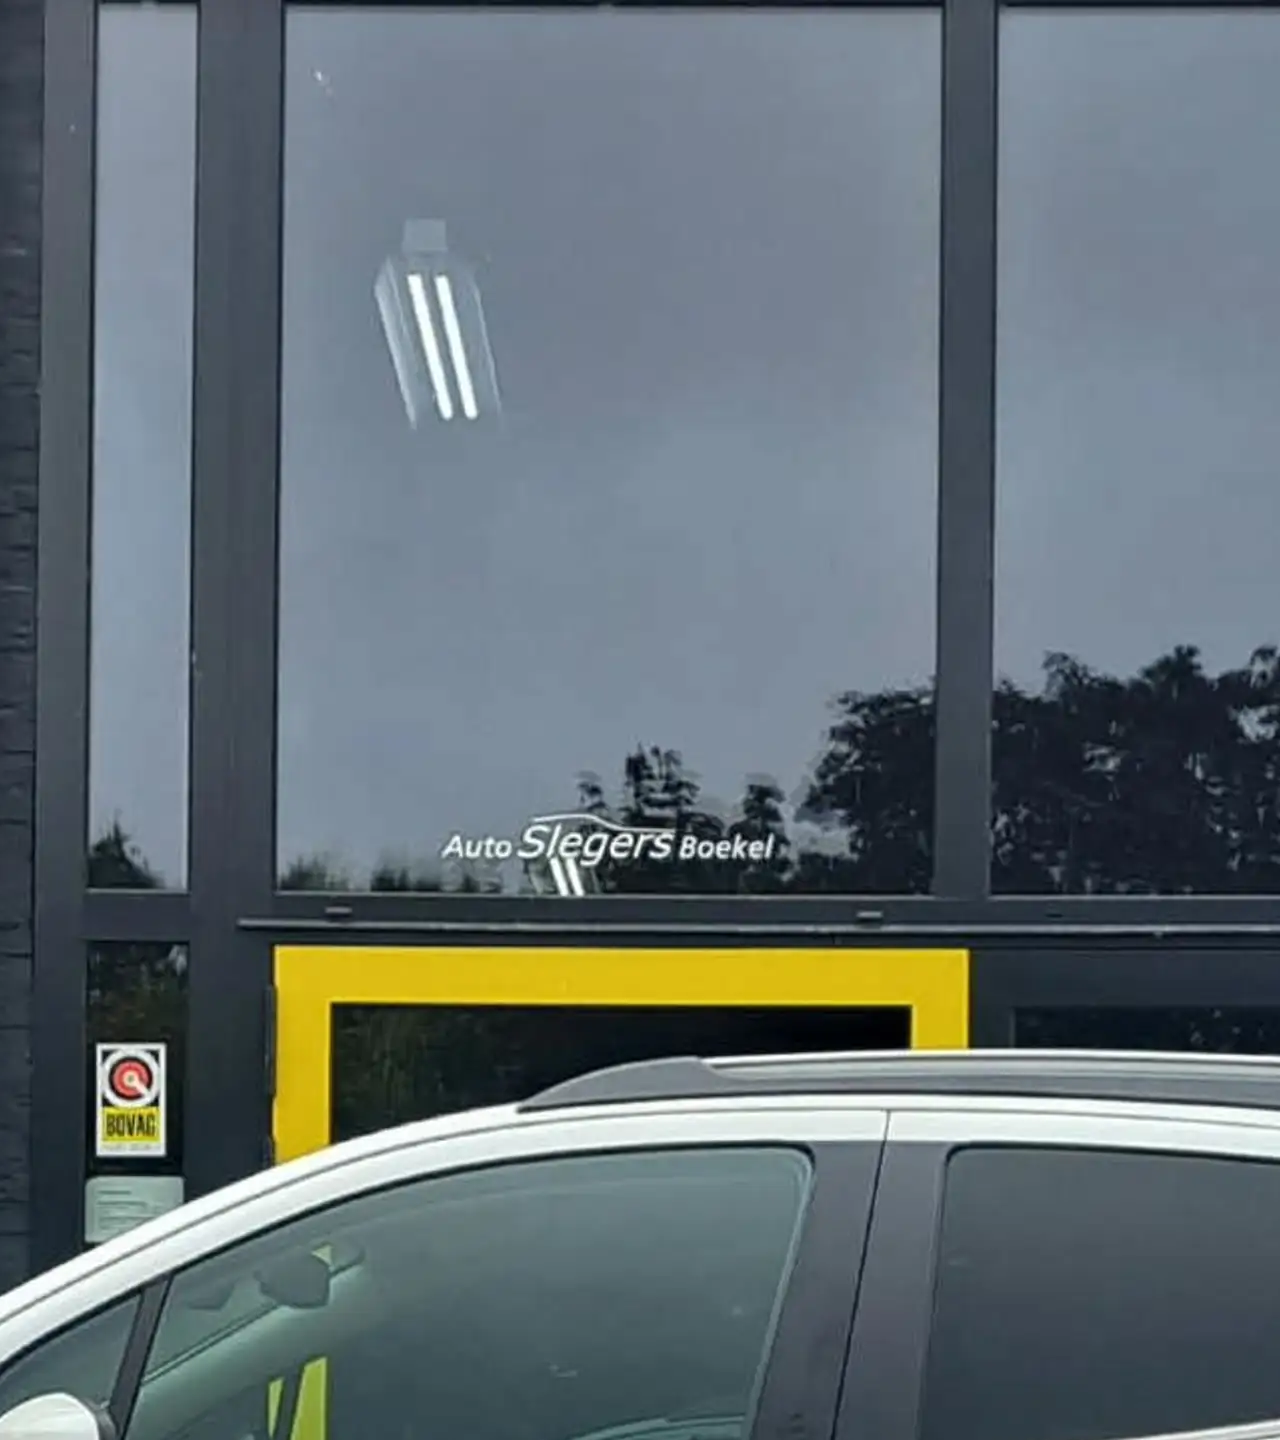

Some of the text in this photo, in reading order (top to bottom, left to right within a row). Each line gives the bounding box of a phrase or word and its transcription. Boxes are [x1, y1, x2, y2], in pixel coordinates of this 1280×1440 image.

[442, 823, 776, 867] Auto Slegers Boekel
[105, 1113, 156, 1137] BOVAG
